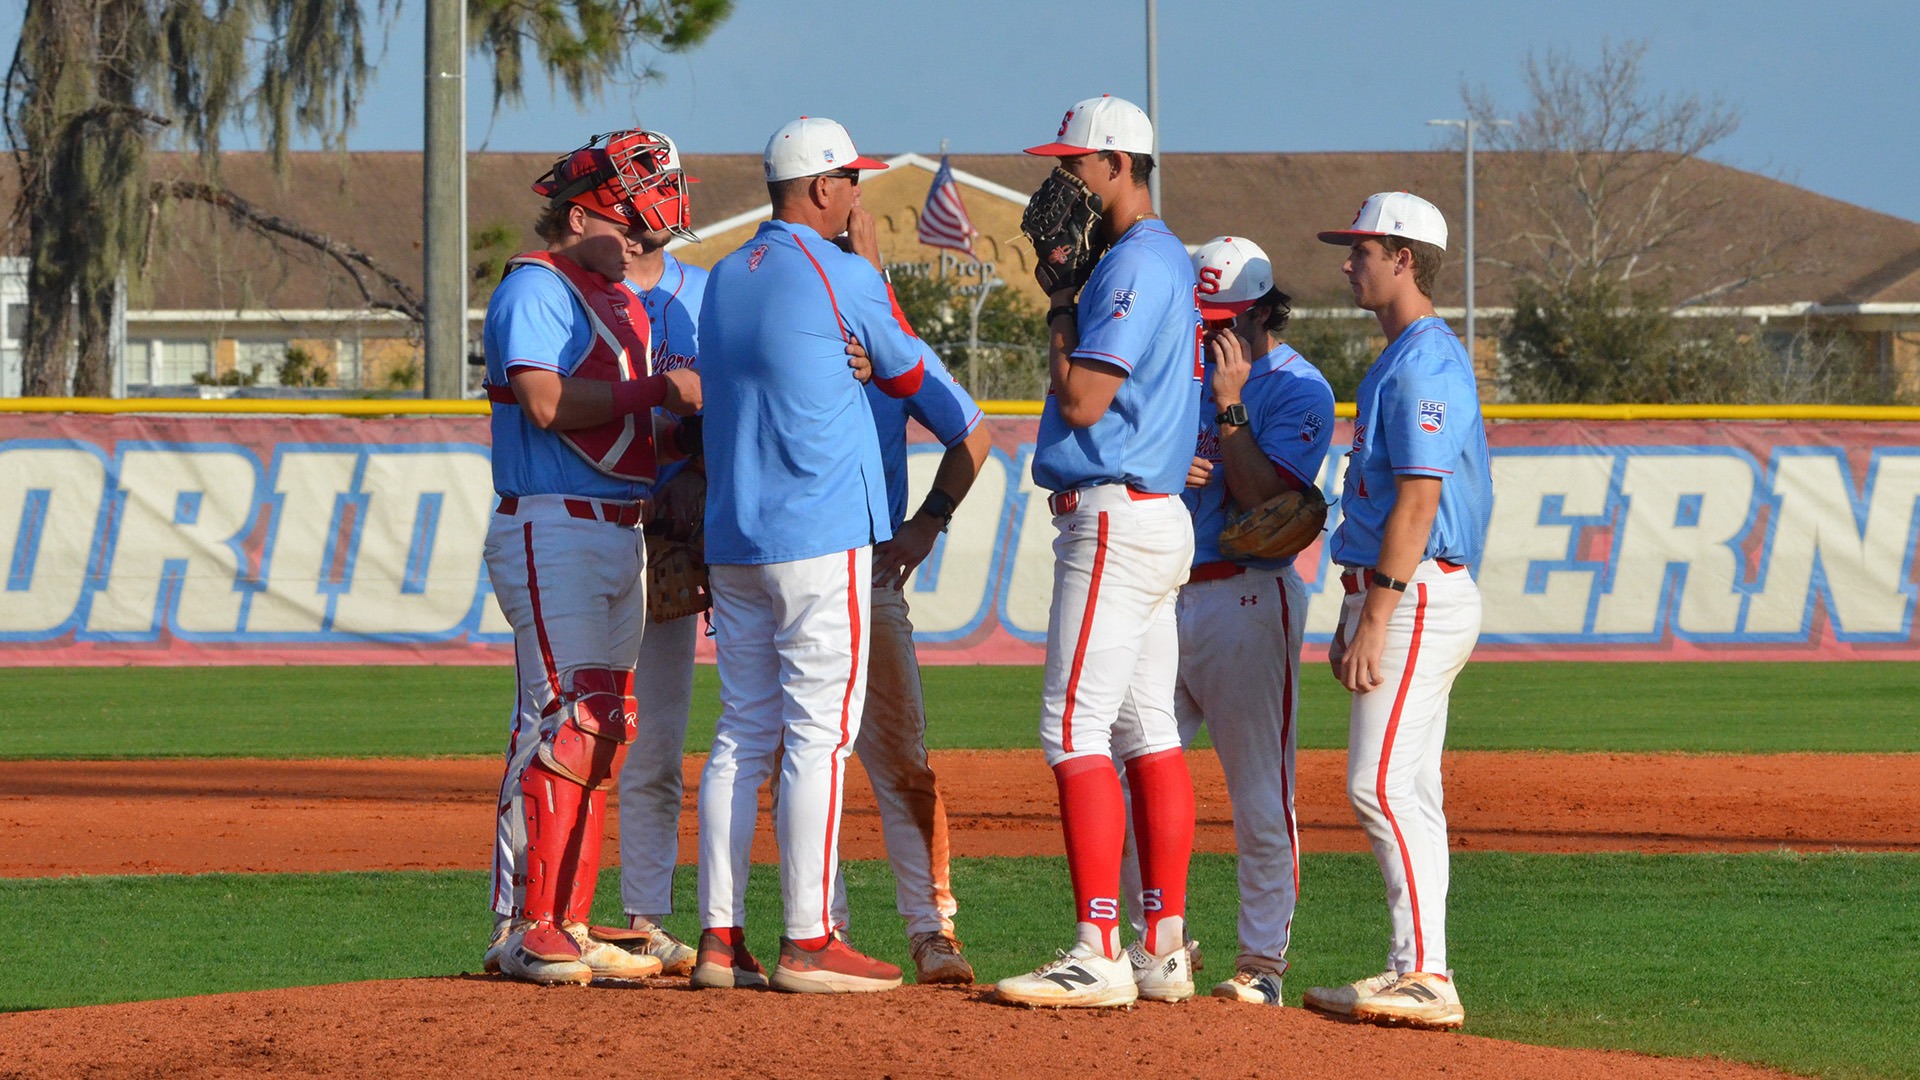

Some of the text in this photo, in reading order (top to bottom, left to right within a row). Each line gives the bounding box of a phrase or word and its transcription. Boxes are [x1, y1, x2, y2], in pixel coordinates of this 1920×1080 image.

[940, 252, 997, 285] Prep
[1198, 266, 1222, 295] S
[1421, 402, 1443, 412] SSC
[1306, 413, 1325, 428] SSC
[0, 442, 514, 642] ORID
[1088, 897, 1118, 920] S
[1043, 965, 1098, 991] N
